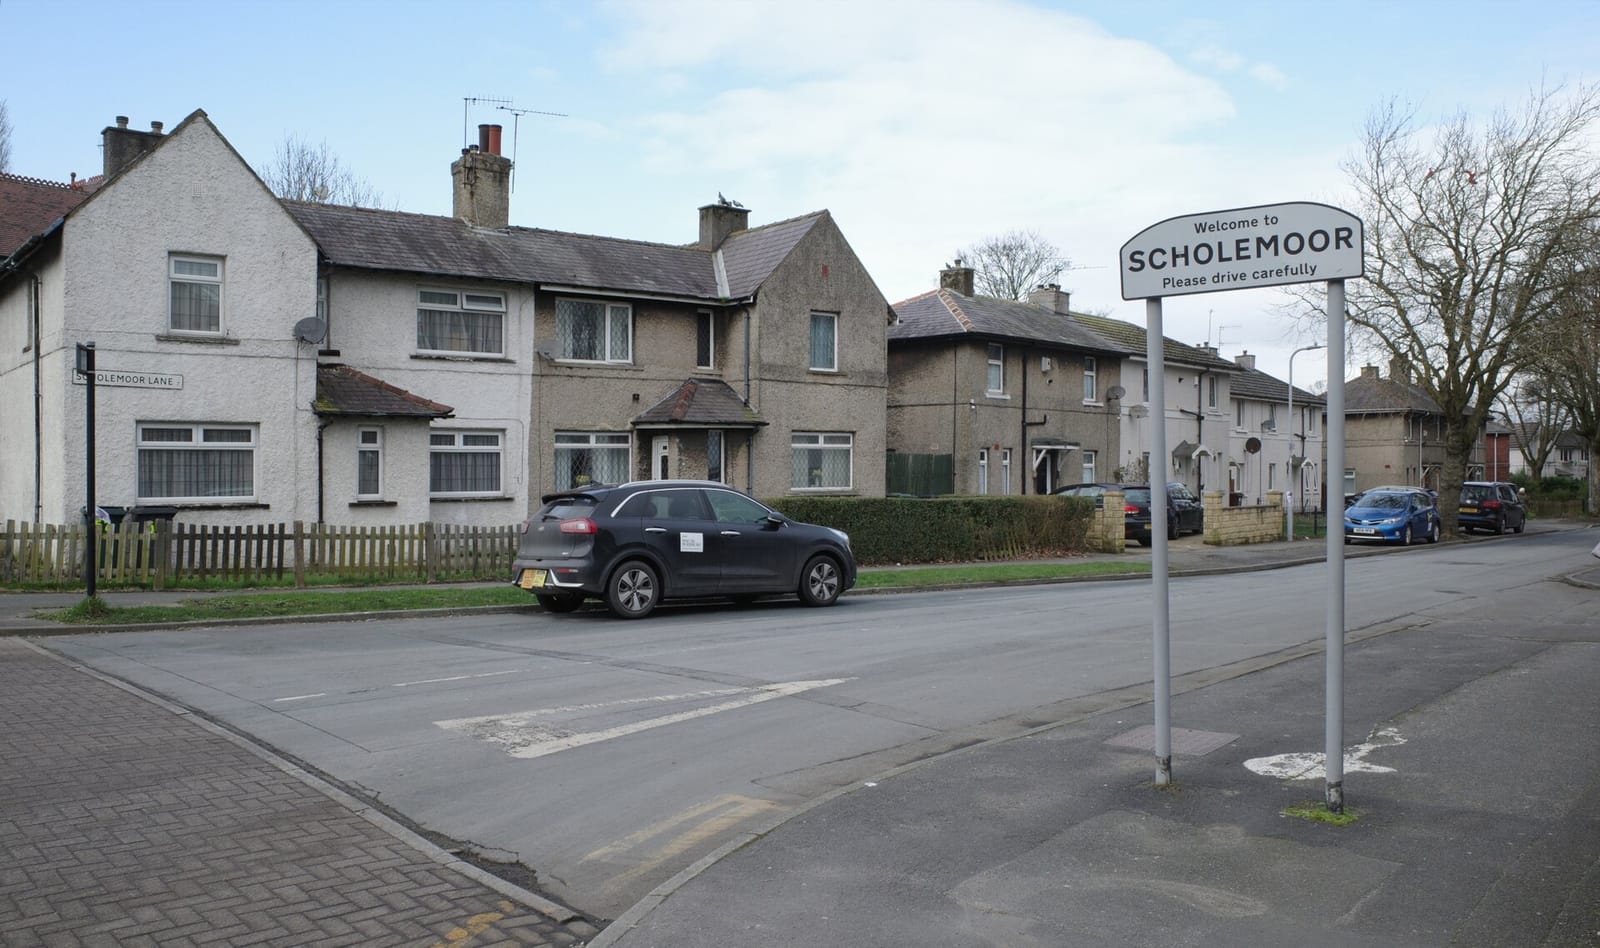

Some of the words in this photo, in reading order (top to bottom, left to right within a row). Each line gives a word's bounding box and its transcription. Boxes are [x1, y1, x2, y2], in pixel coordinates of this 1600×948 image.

[1194, 217, 1258, 234] Welcome
[1263, 214, 1279, 226] to
[1128, 226, 1354, 273] SCHOLEMOOR
[1162, 276, 1207, 289] Please
[1211, 271, 1247, 284] drive
[1252, 263, 1317, 280] carefully
[76, 372, 145, 384] SCOLEMOOR
[148, 376, 173, 386] LANE
